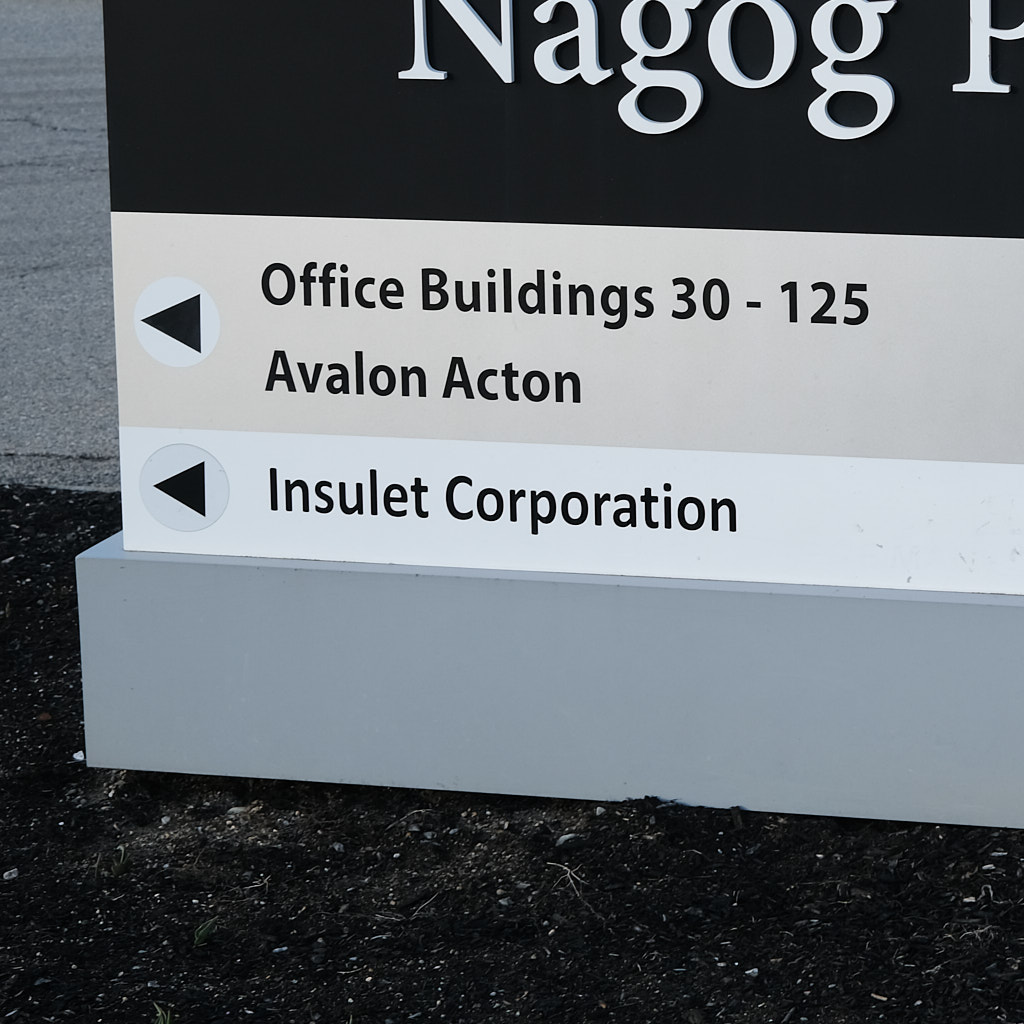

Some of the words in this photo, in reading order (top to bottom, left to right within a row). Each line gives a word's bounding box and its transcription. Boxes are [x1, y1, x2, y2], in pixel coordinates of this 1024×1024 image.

[261, 262, 405, 310] Office
[421, 267, 656, 330] Buildings
[671, 276, 730, 321] 30
[746, 301, 762, 309] -
[780, 281, 869, 326] 125
[264, 349, 427, 398] Avalon
[442, 356, 582, 404] Acton
[269, 467, 429, 520] Insulet
[445, 475, 737, 536] Corporation
